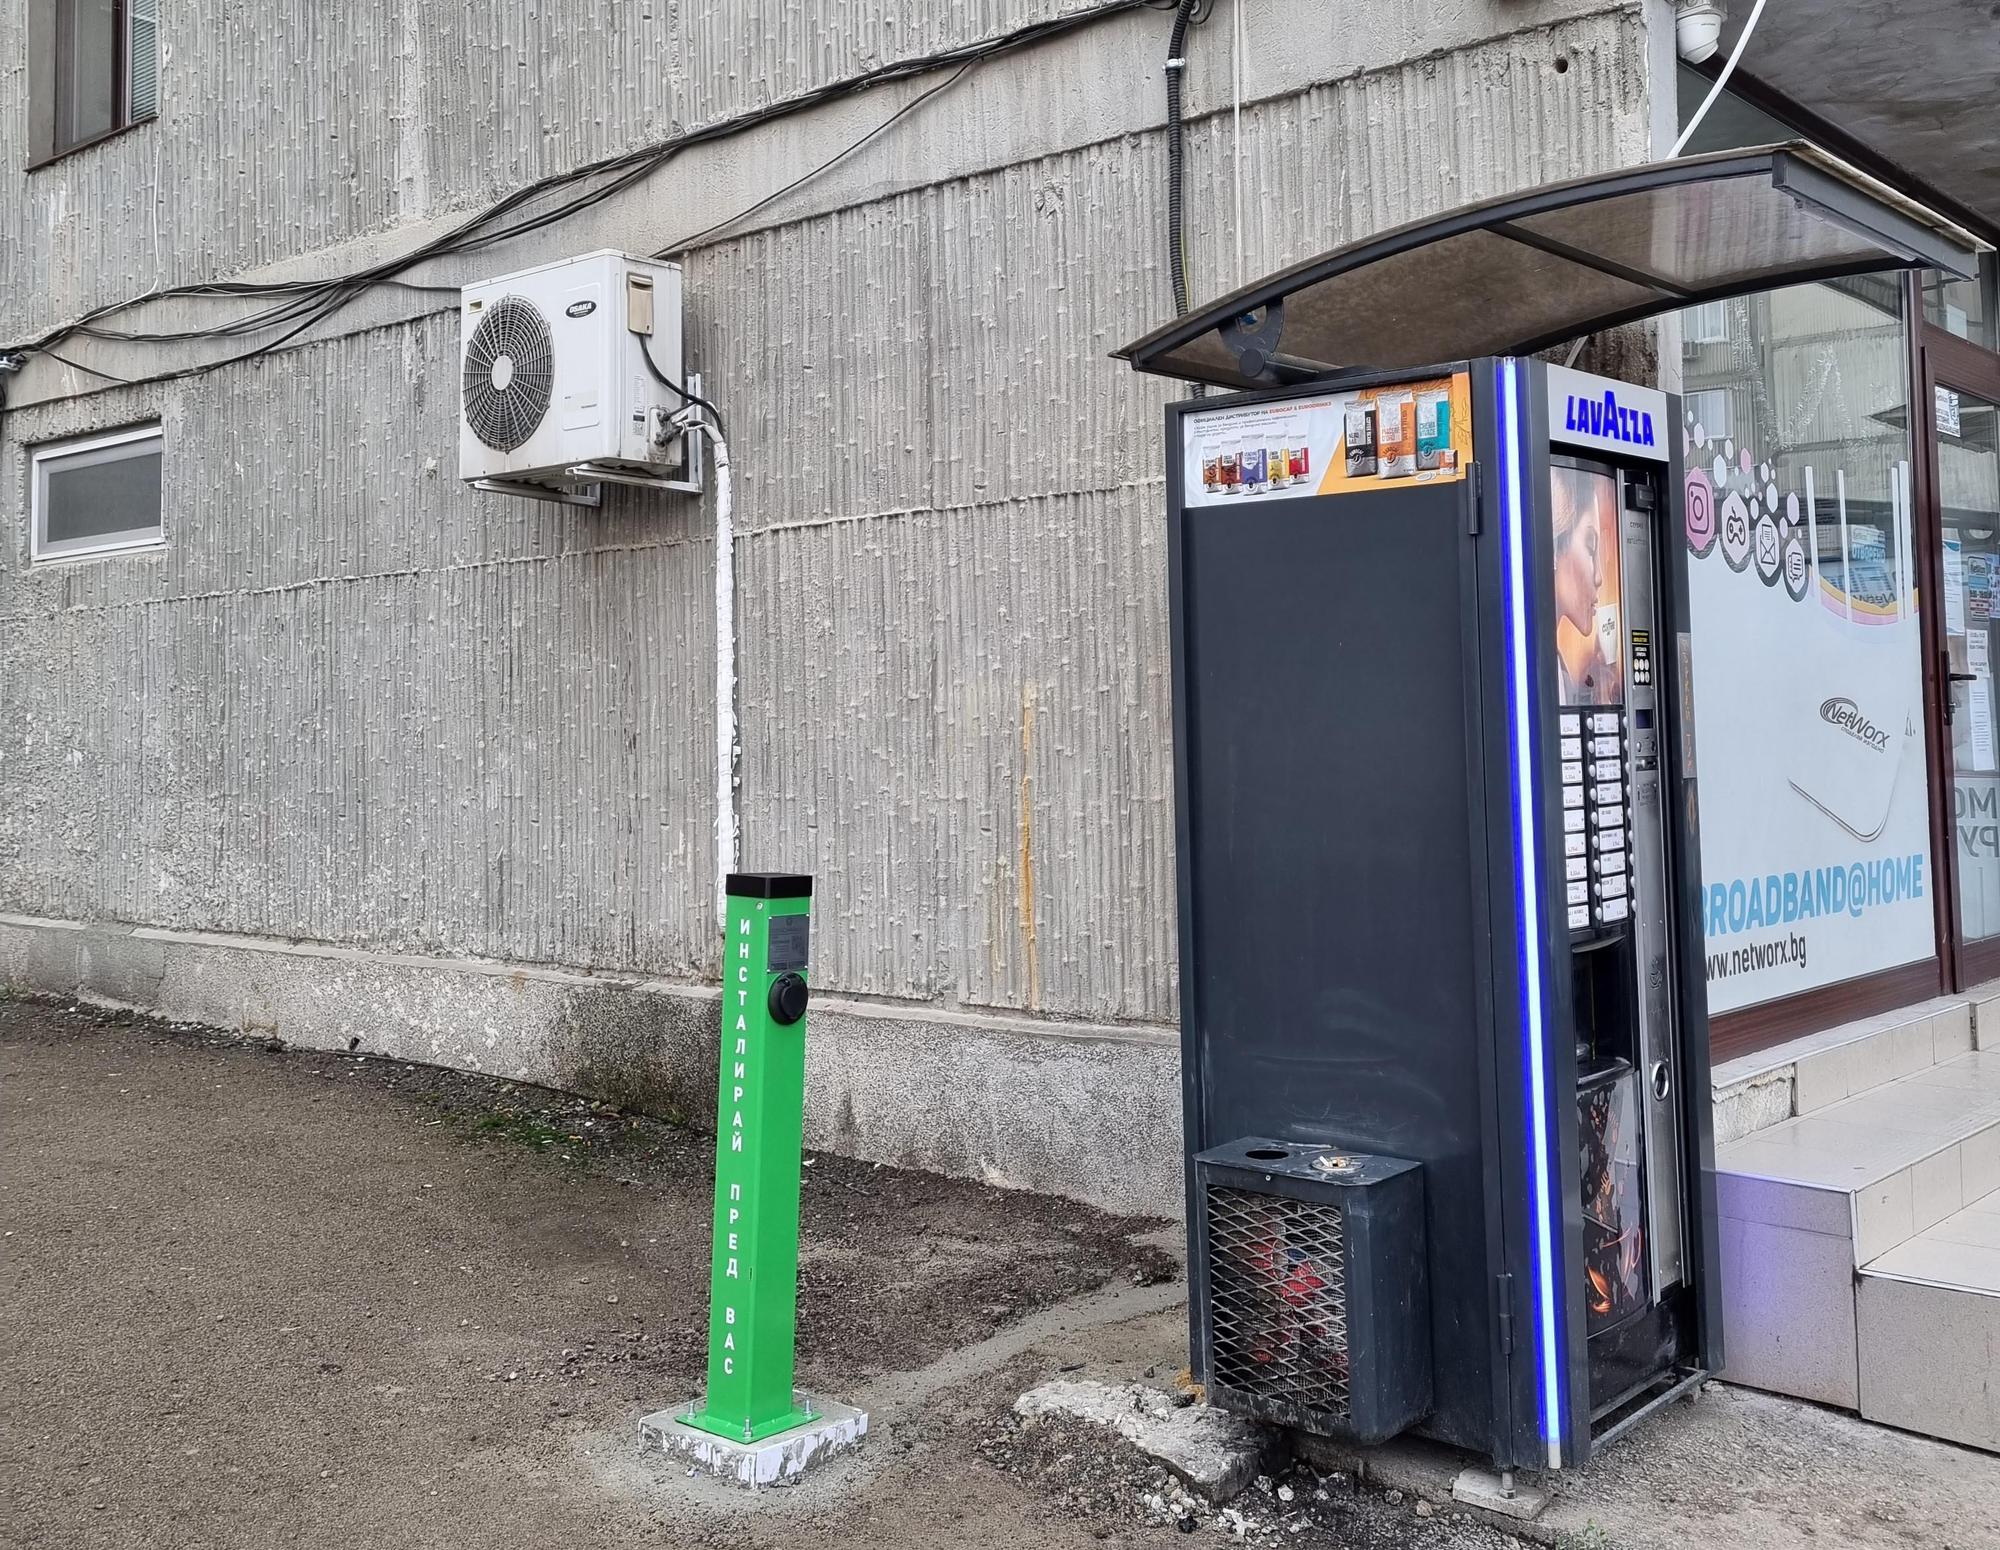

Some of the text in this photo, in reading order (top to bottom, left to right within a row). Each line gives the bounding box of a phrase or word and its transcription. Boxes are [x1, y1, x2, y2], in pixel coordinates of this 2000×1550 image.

[1566, 390, 1654, 447] LAVAZZA
[724, 919, 750, 1375] ИНСТАЛИРАЙ ПРЕД ВАС
